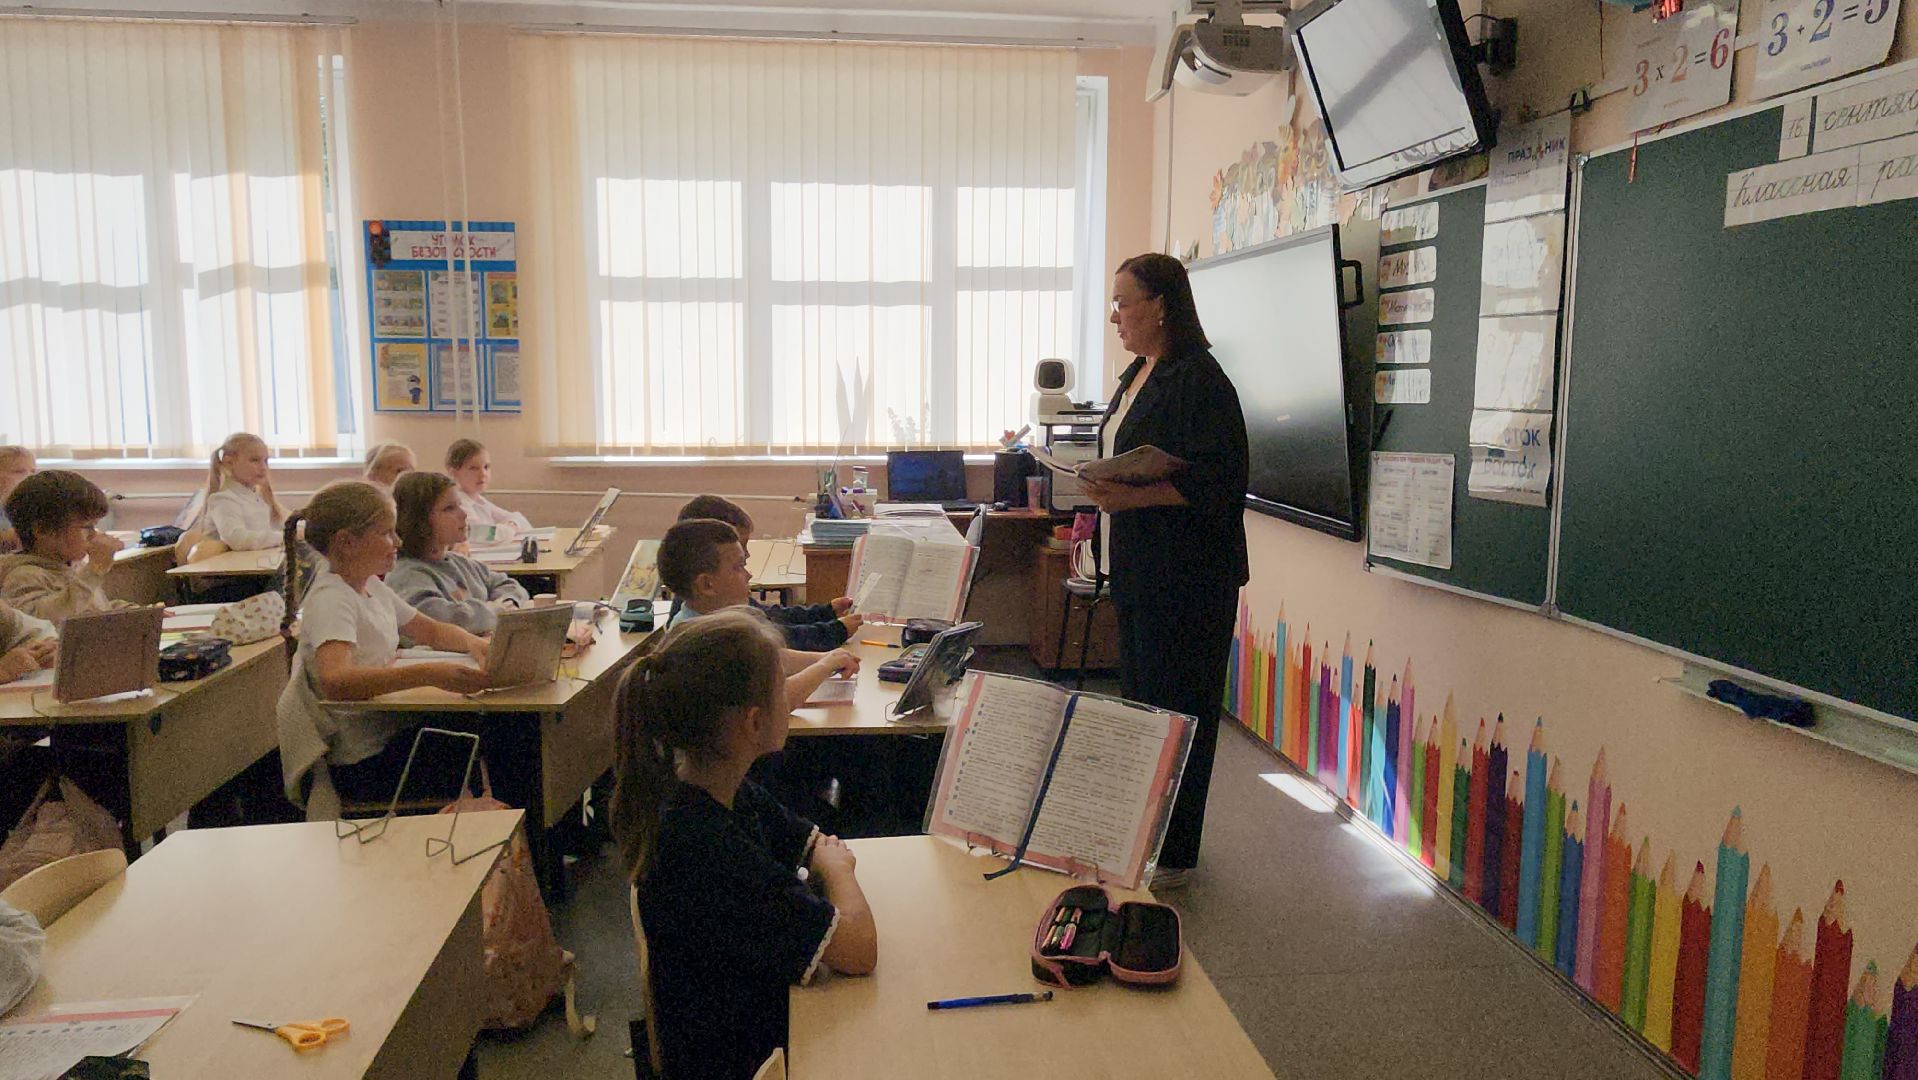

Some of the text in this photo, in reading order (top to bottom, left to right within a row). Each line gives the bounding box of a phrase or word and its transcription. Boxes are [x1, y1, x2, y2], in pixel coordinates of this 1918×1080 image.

[1767, 12, 1789, 56] 3
[1809, 0, 1834, 43] 2
[1633, 59, 1649, 97] 3
[1670, 45, 1688, 84] 2
[1710, 28, 1729, 70] 6
